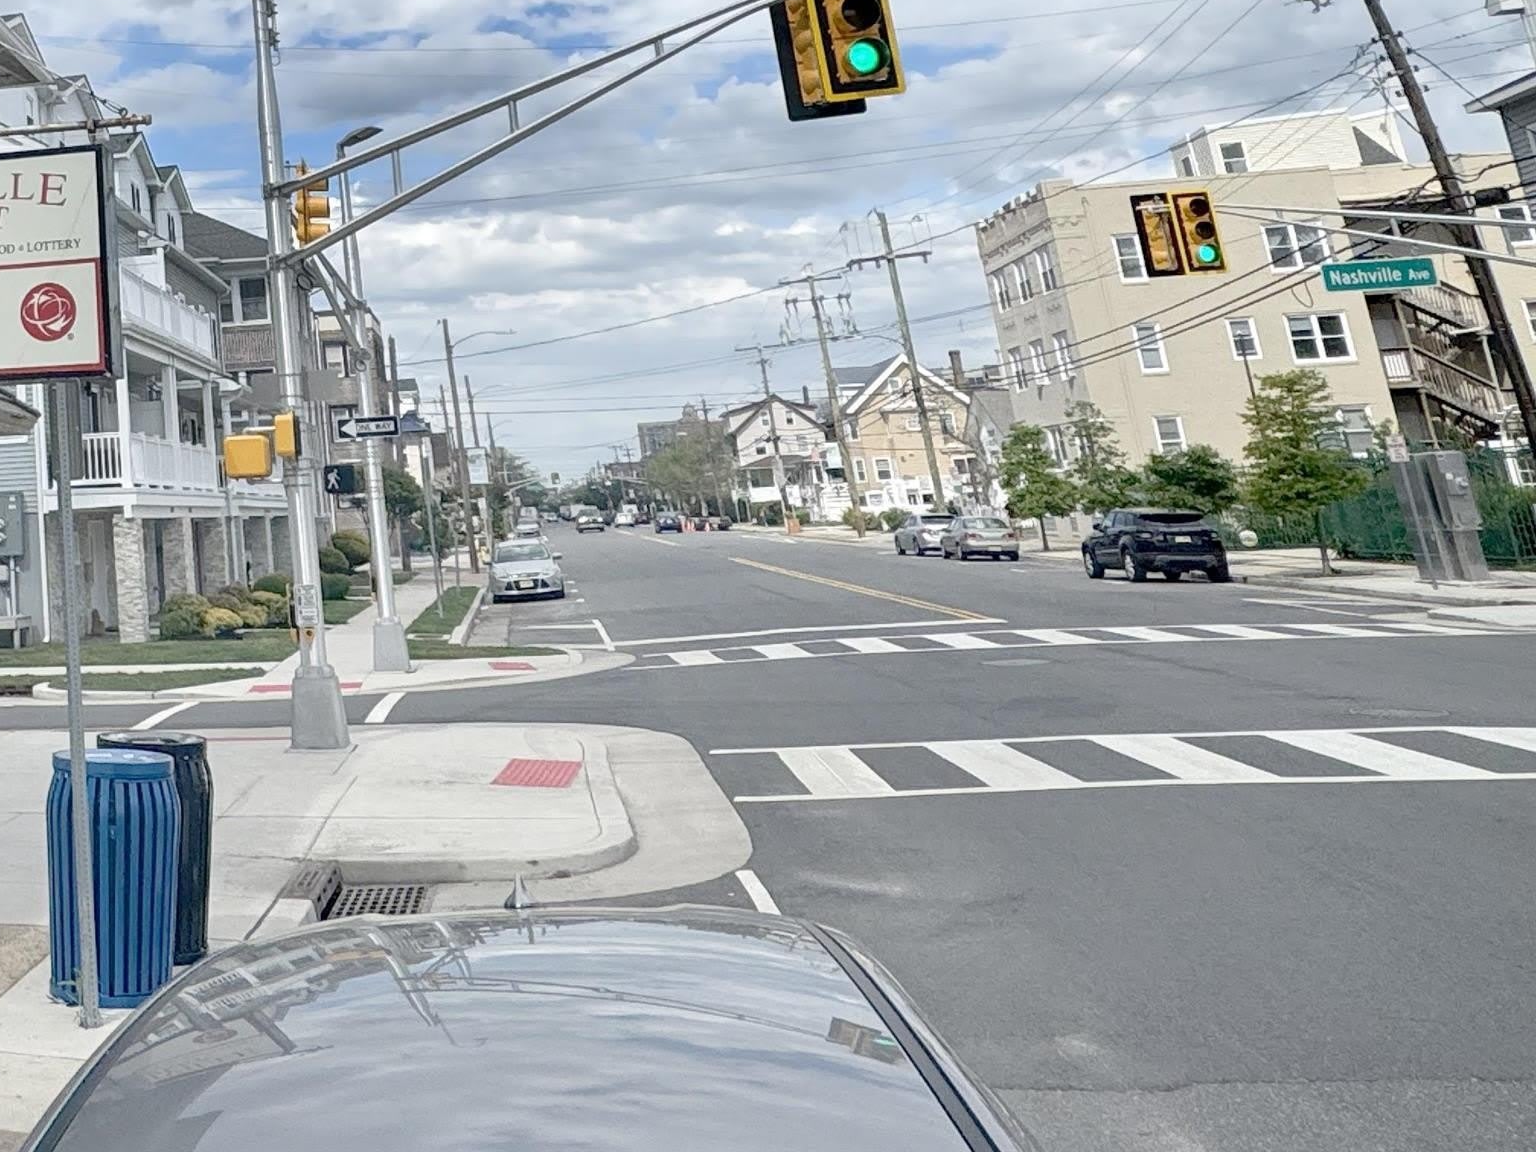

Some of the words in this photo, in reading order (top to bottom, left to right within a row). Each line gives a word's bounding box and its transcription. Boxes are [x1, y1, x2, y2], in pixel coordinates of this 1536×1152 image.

[27, 239, 81, 253] LOTTERY
[1329, 267, 1402, 286] Nashville
[1408, 268, 1431, 281] Ave
[375, 422, 392, 430] WAY
